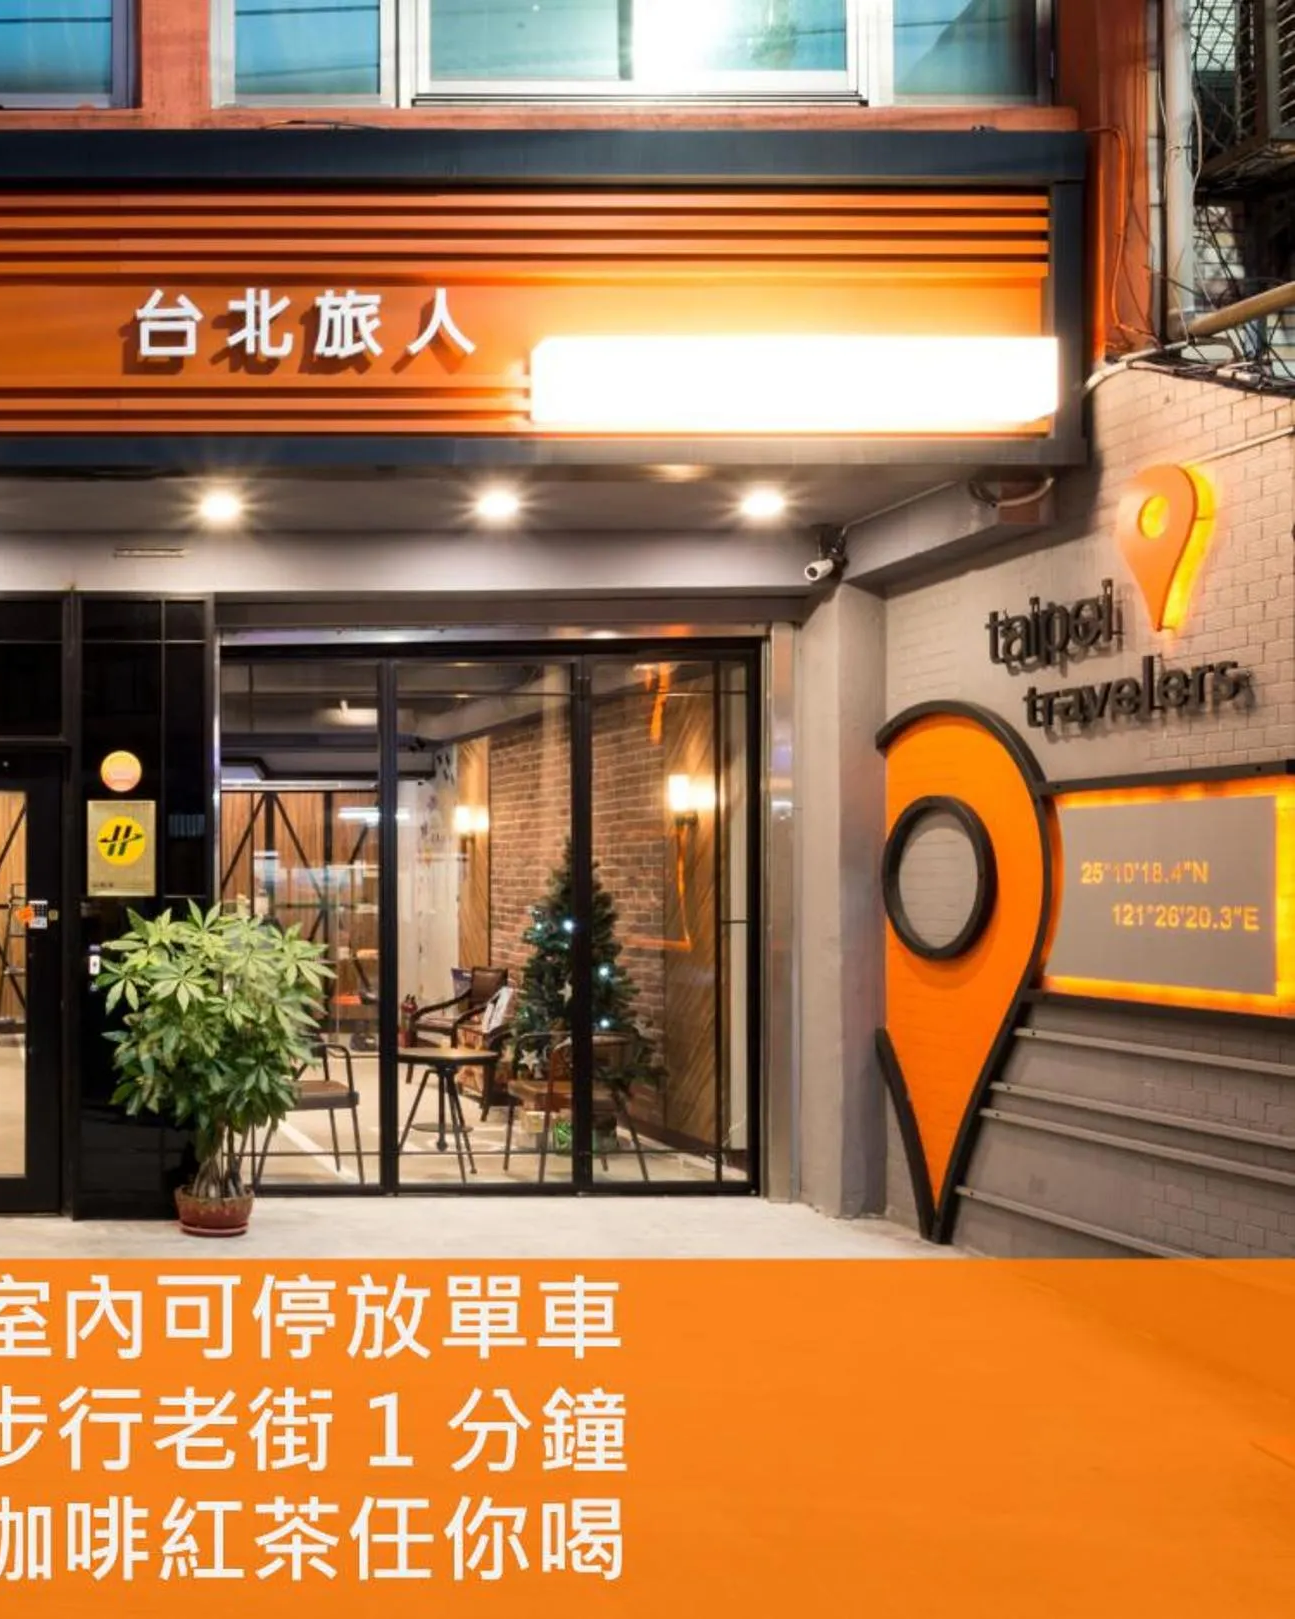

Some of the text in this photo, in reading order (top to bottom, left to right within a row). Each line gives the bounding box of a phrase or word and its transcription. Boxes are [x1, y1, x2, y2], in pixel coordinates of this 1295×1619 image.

[136, 287, 475, 358] 台北旅人
[985, 578, 1115, 668] taipei
[1023, 655, 1244, 728] travelers
